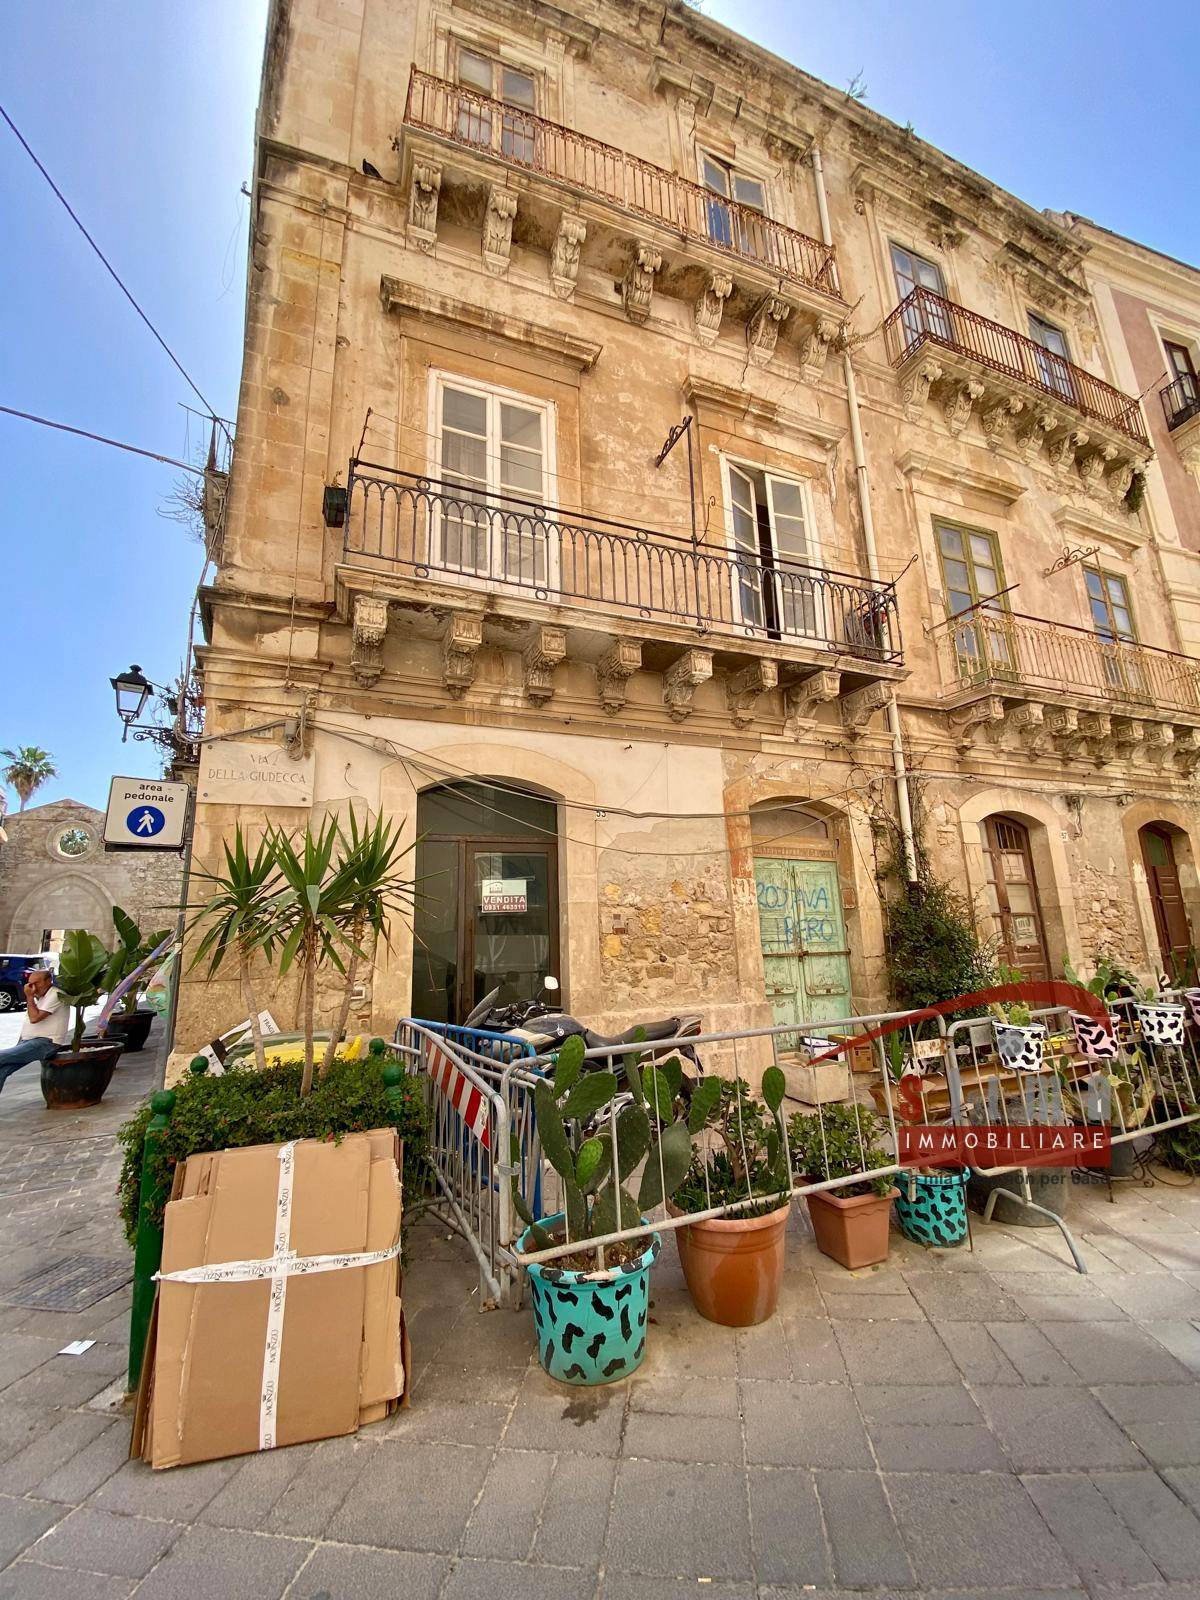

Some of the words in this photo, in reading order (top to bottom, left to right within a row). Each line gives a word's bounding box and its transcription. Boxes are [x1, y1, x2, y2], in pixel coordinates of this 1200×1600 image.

[208, 768, 246, 781] DELLA
[249, 771, 307, 784] GIUDECCA
[139, 784, 163, 792] area
[124, 792, 174, 803] pedonale
[483, 896, 526, 904] VENDITA
